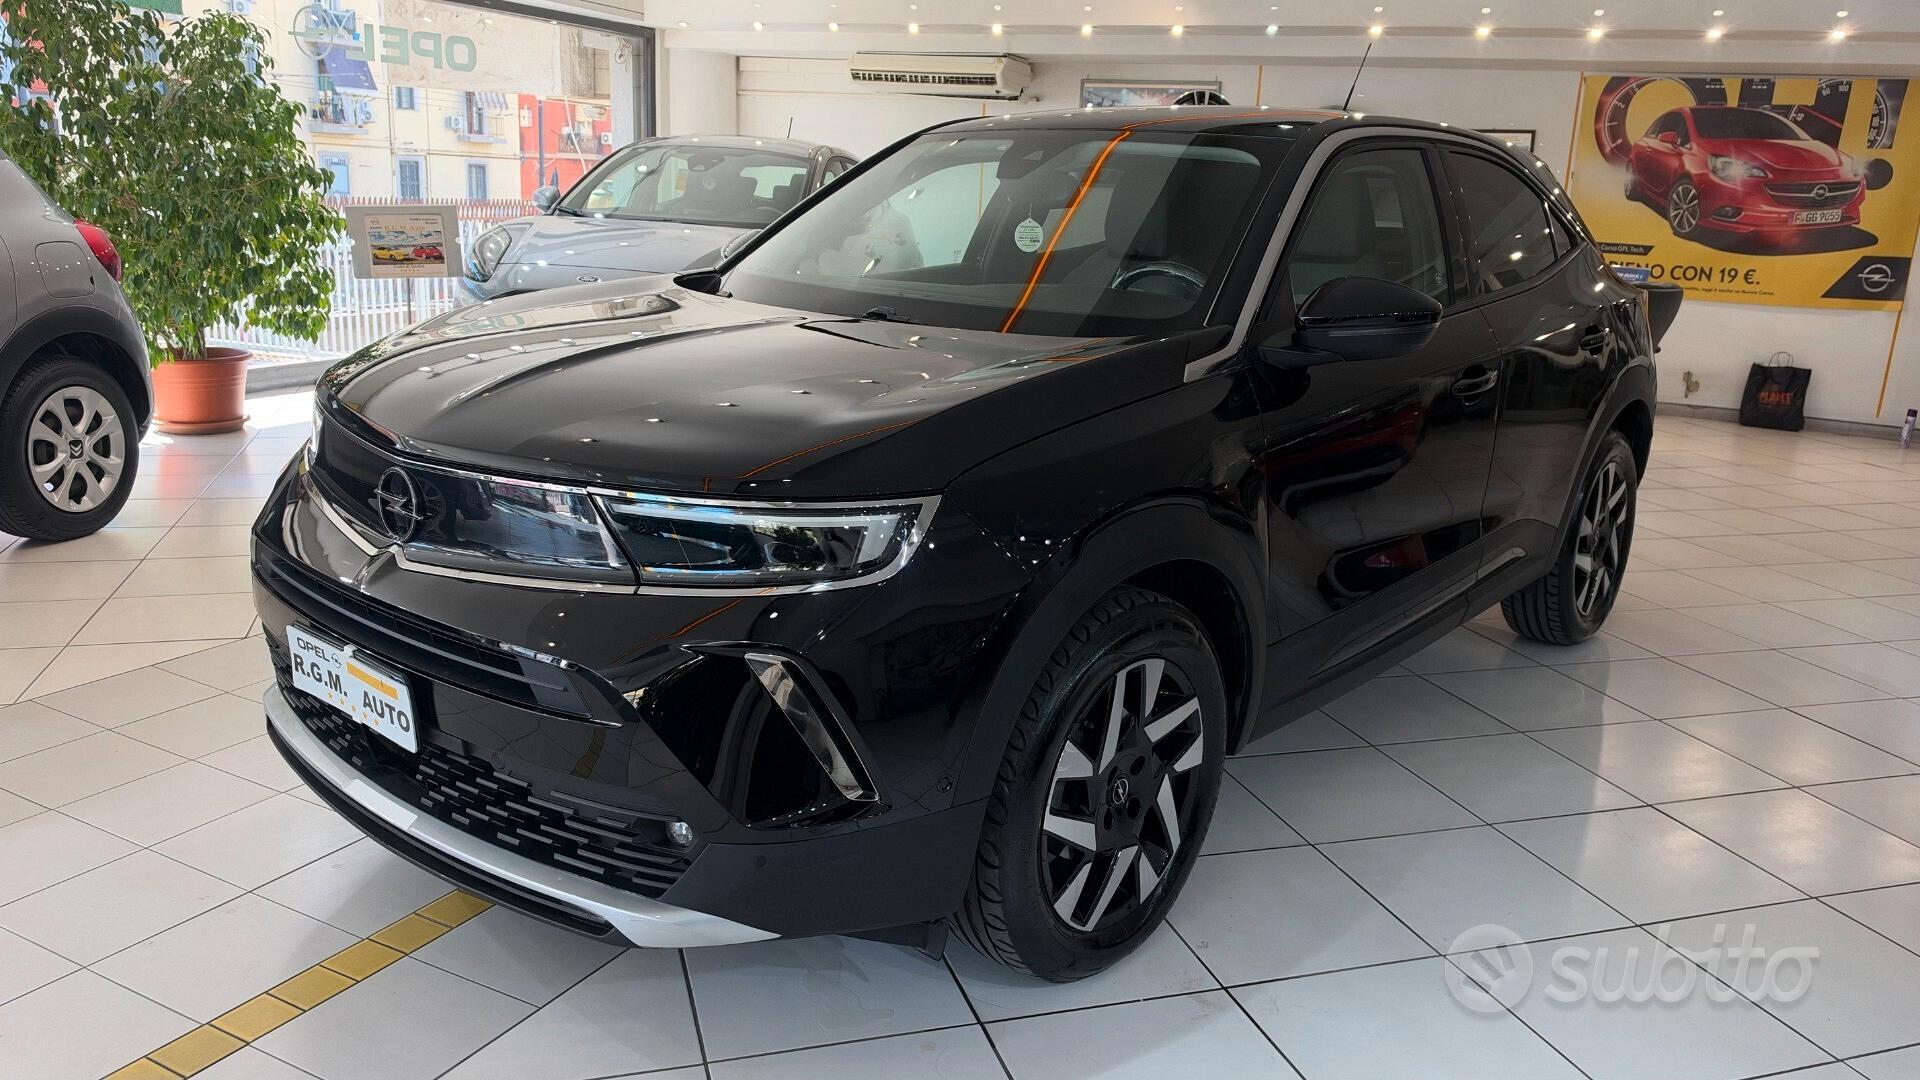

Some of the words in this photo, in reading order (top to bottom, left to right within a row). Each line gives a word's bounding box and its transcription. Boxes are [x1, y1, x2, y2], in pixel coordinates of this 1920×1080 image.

[1819, 211, 1841, 222] 9055
[1670, 264, 1713, 283] CON
[1719, 267, 1738, 283] 19
[1743, 268, 1761, 285] €.
[296, 636, 330, 663] OPEL
[293, 652, 348, 698] R.G.M.
[363, 689, 411, 733] AUTO
